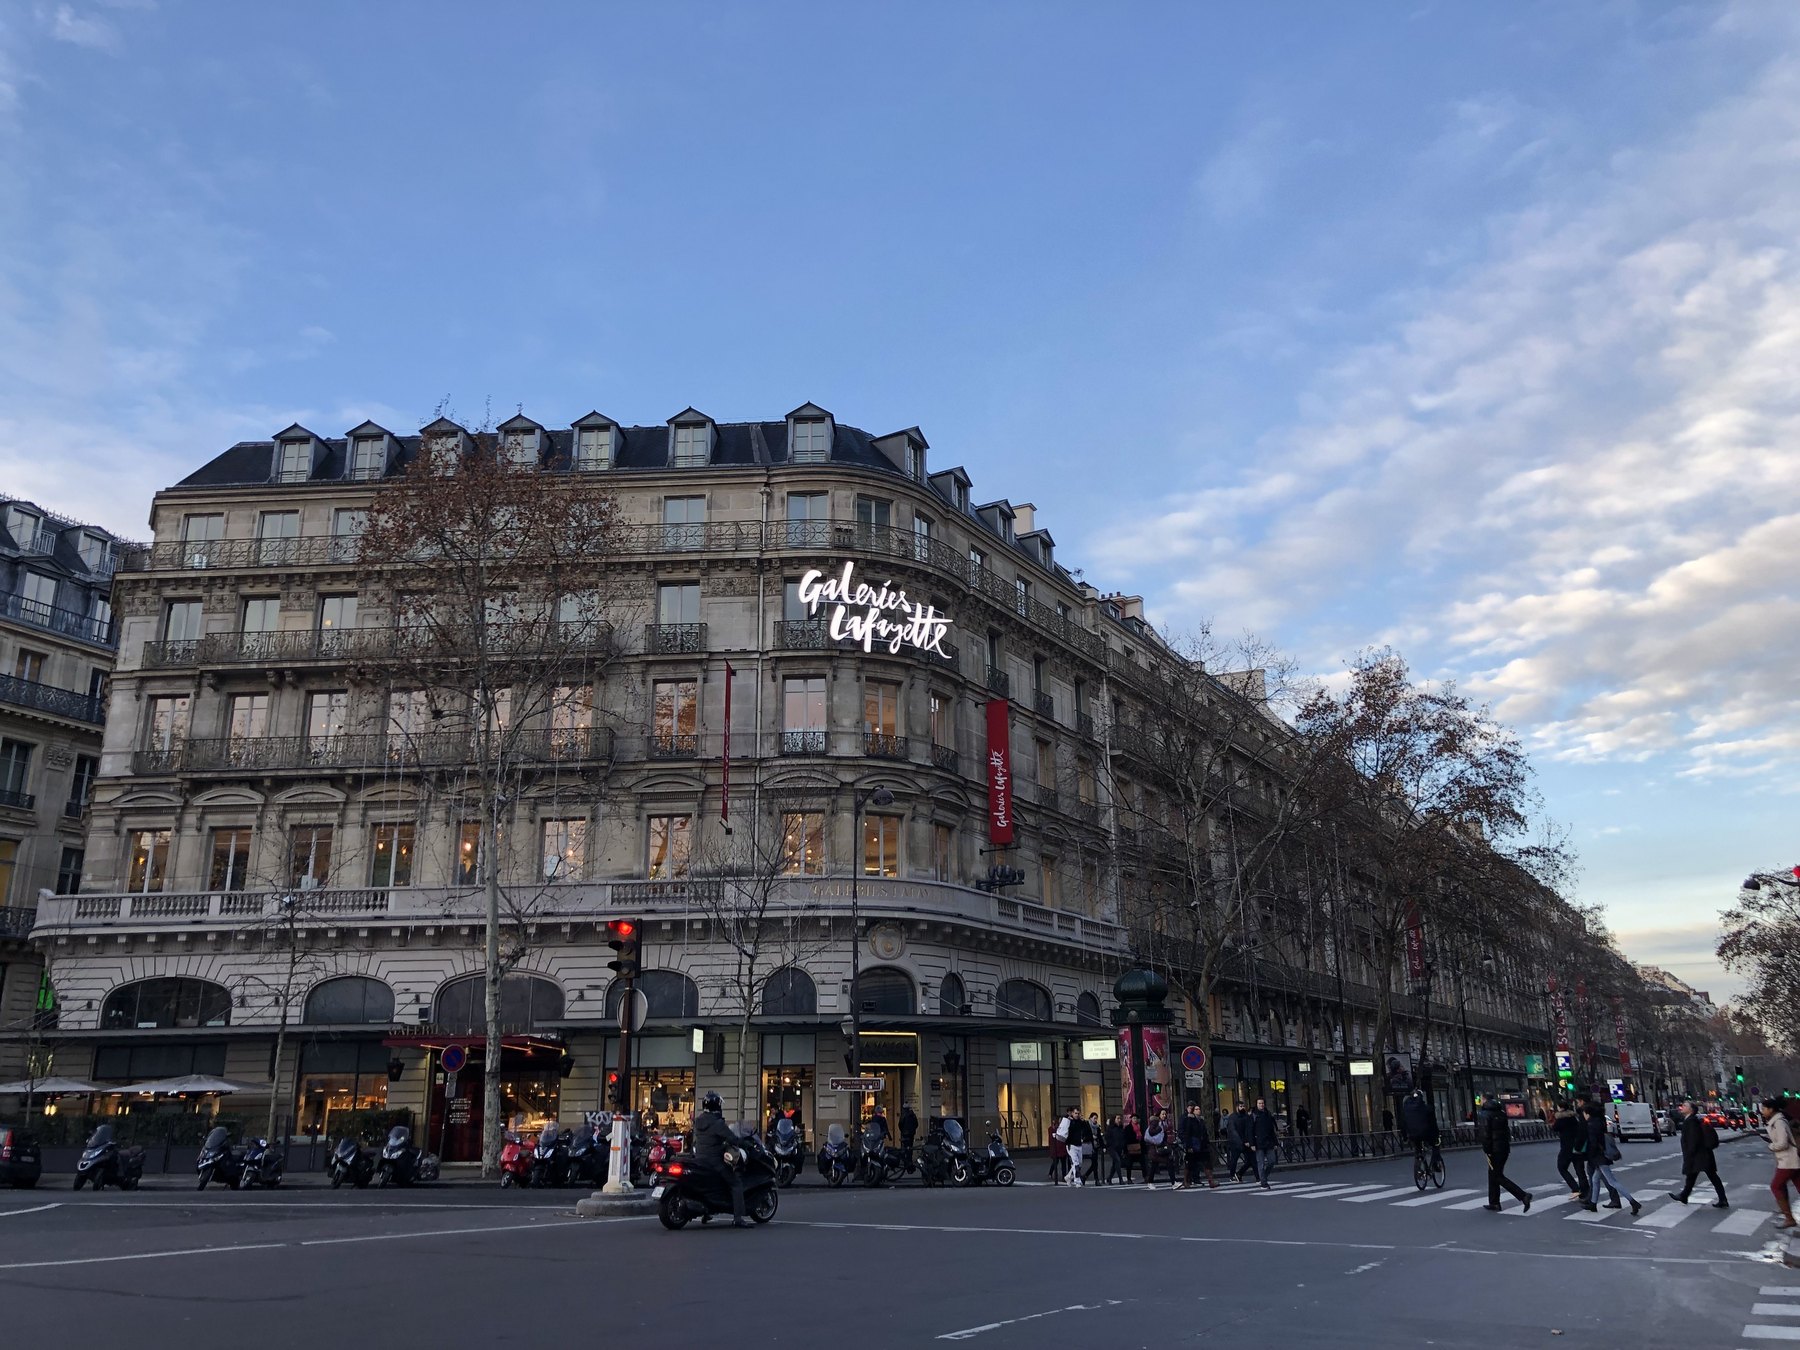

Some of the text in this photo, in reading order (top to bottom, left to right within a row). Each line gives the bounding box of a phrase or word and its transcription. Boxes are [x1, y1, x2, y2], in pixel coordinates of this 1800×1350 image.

[798, 561, 912, 615] Galeries
[830, 603, 954, 659] Lafayette
[990, 748, 1010, 827] Galeries Lafayette
